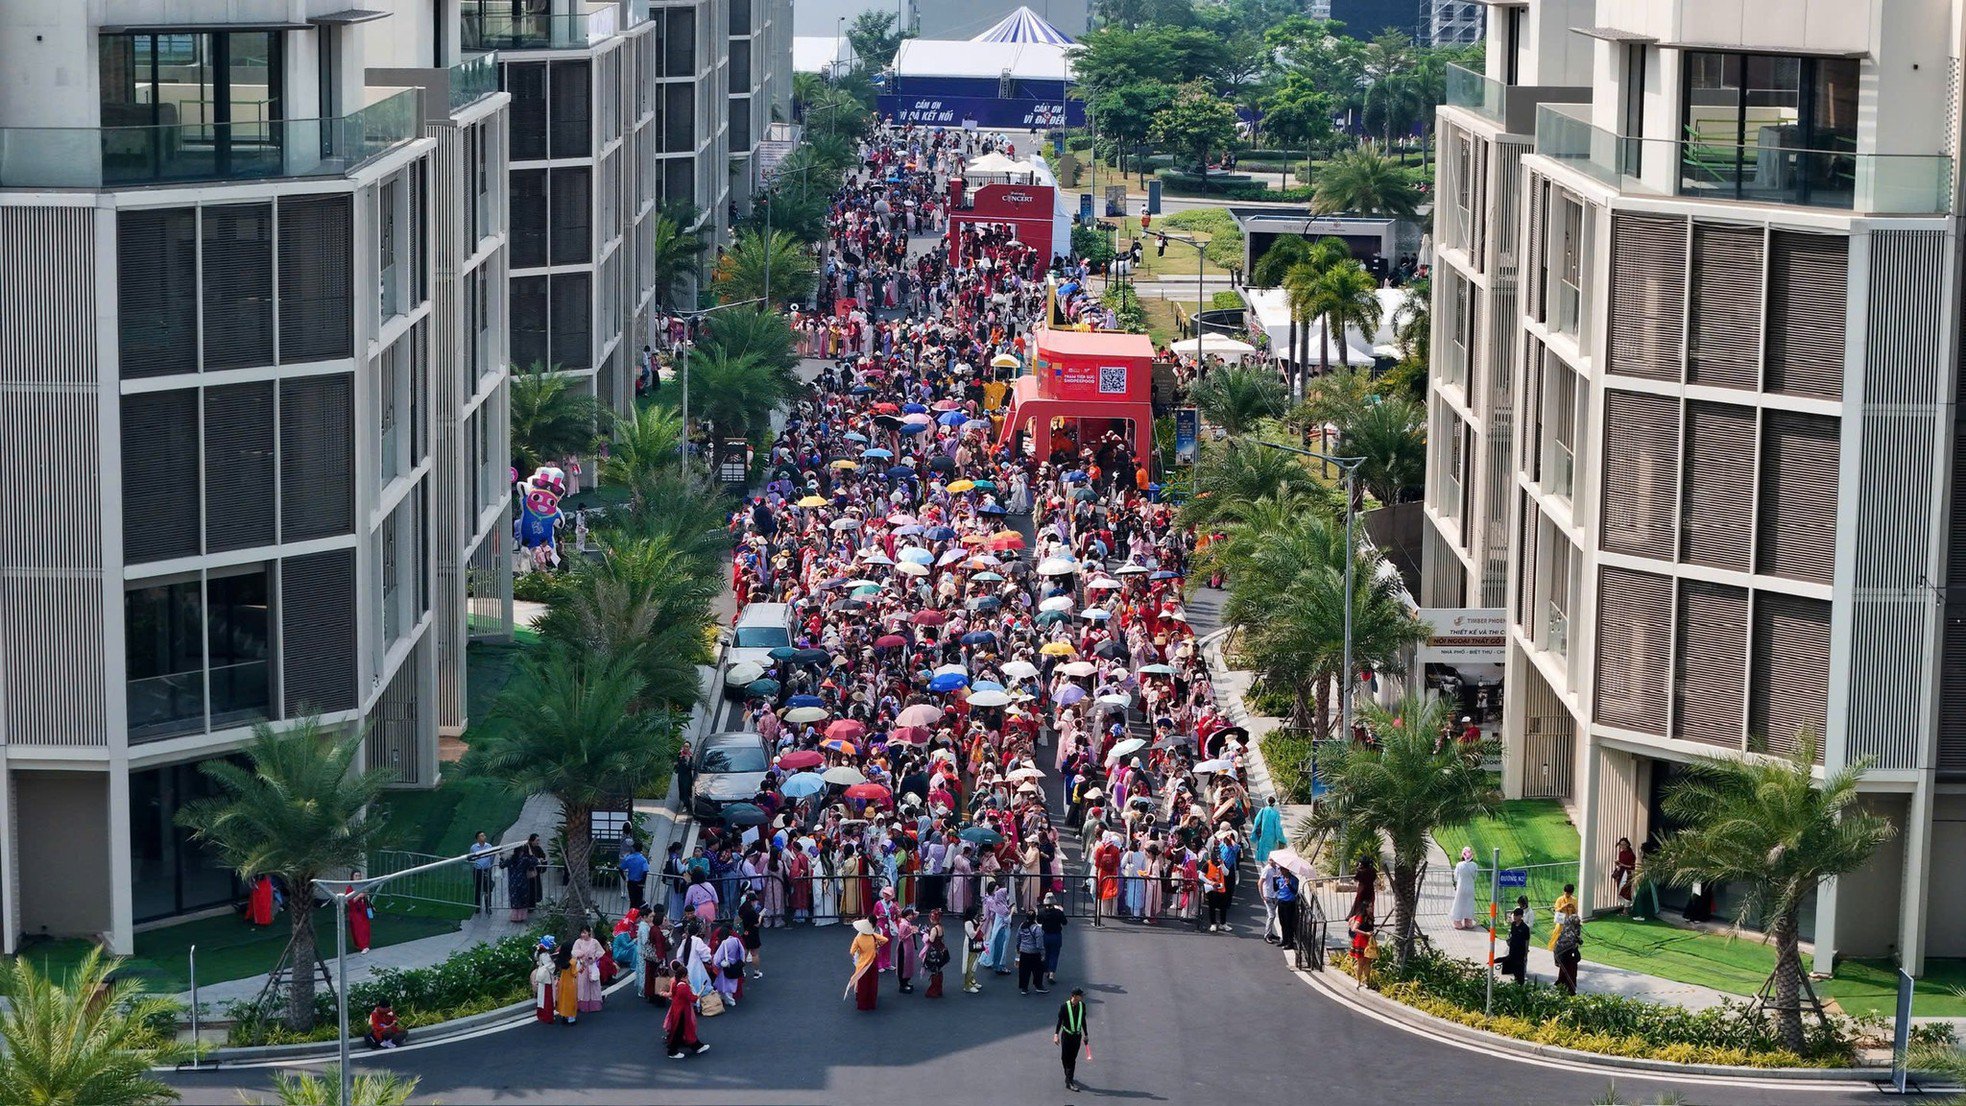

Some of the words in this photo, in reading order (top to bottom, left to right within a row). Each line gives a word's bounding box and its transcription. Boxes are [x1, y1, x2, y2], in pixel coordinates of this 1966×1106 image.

[899, 108, 908, 120] VÌ
[921, 109, 938, 121] KẾT
[1023, 112, 1034, 124] VÌ
